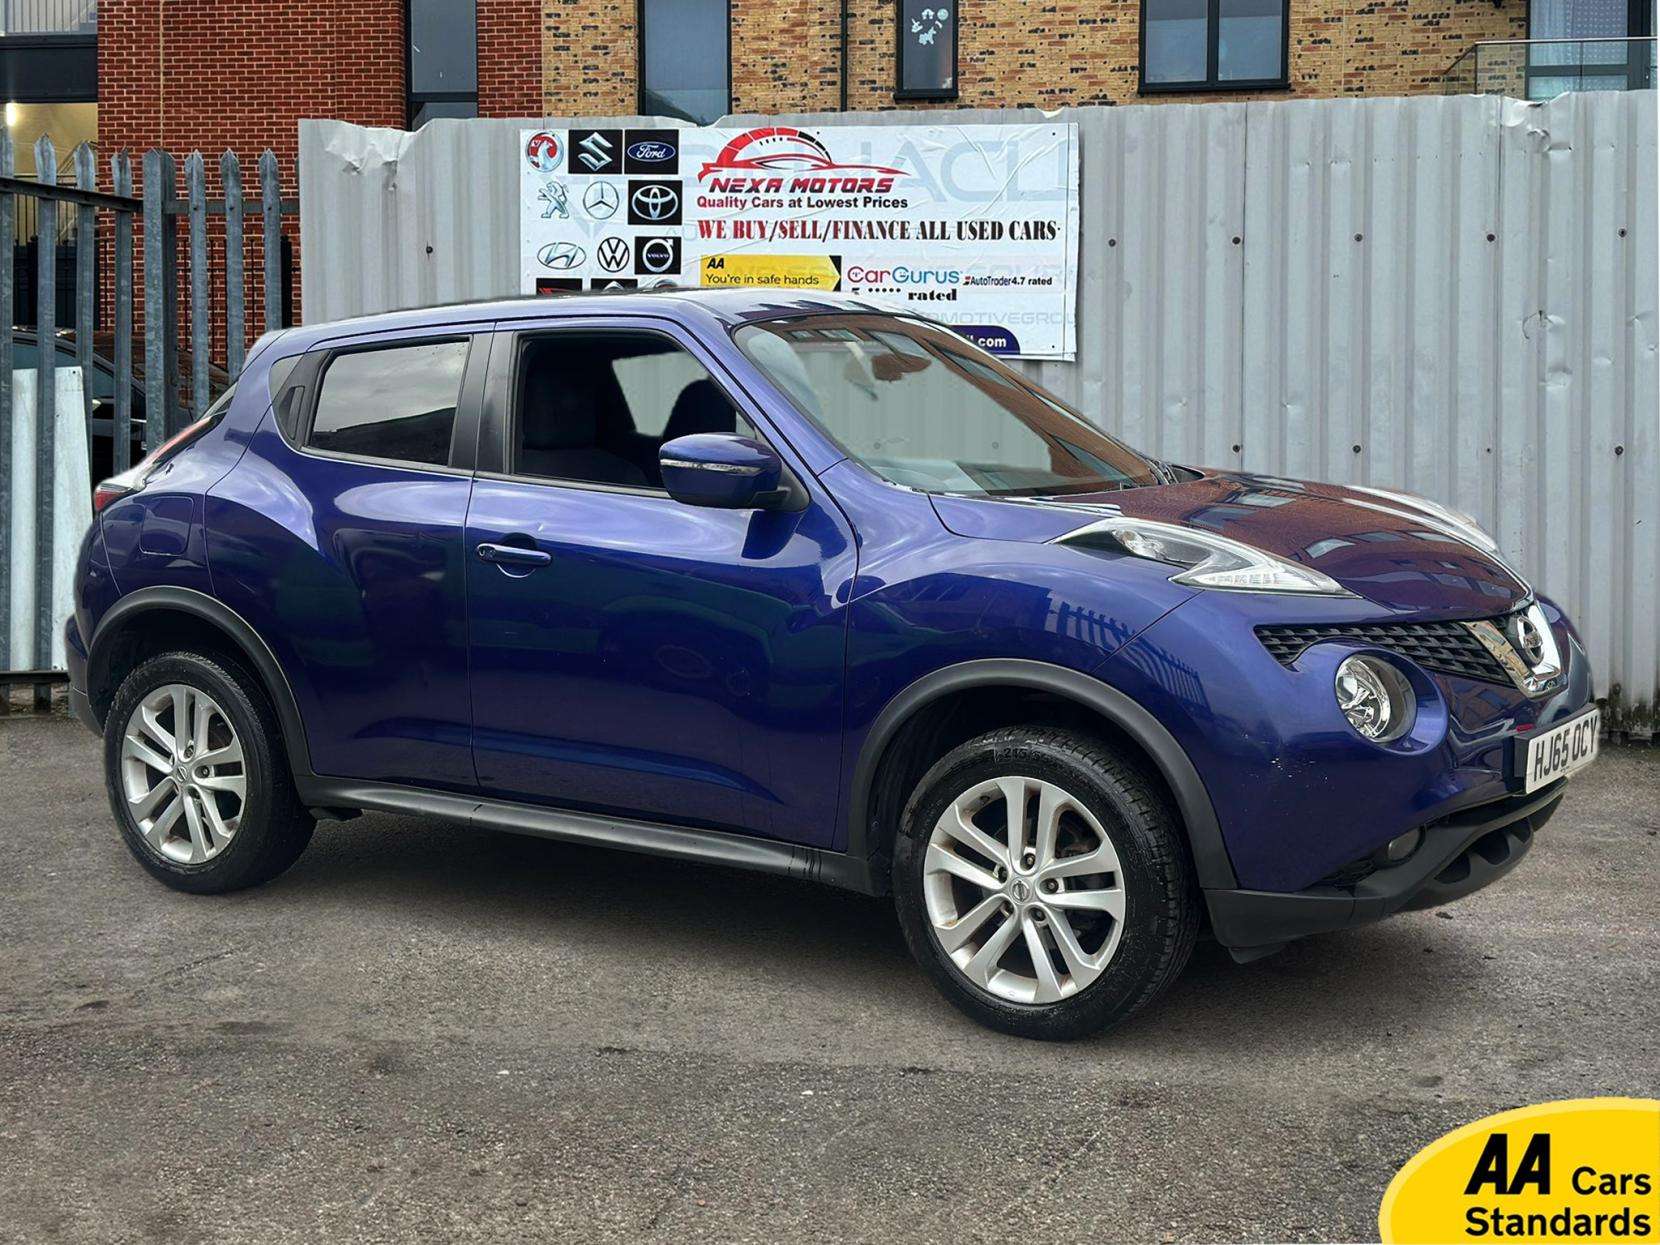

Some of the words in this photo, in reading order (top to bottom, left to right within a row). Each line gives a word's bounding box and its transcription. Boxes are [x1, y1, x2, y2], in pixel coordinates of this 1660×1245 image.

[636, 144, 666, 159] Ford
[709, 177, 783, 193] NEXA
[789, 177, 895, 193] MOTORS
[697, 196, 747, 211] Quality
[752, 196, 785, 208] Cars
[788, 197, 802, 208] at
[807, 196, 859, 208] Lowest
[863, 196, 908, 208] Prices
[697, 220, 727, 240] WE
[733, 219, 911, 243] BUY/SELL/FINANCE
[916, 220, 951, 240] ALL
[957, 220, 1003, 241] USED
[1008, 220, 1057, 241] CARS
[706, 257, 725, 269] AA
[706, 273, 741, 284] You're
[744, 273, 753, 284] in
[757, 273, 781, 285] safe
[784, 273, 819, 286] hands
[847, 266, 960, 284] CarGurus
[1028, 276, 1052, 286] rated
[908, 288, 957, 301] rated
[1533, 728, 1570, 782] HJ65
[1572, 715, 1598, 761] OCY
